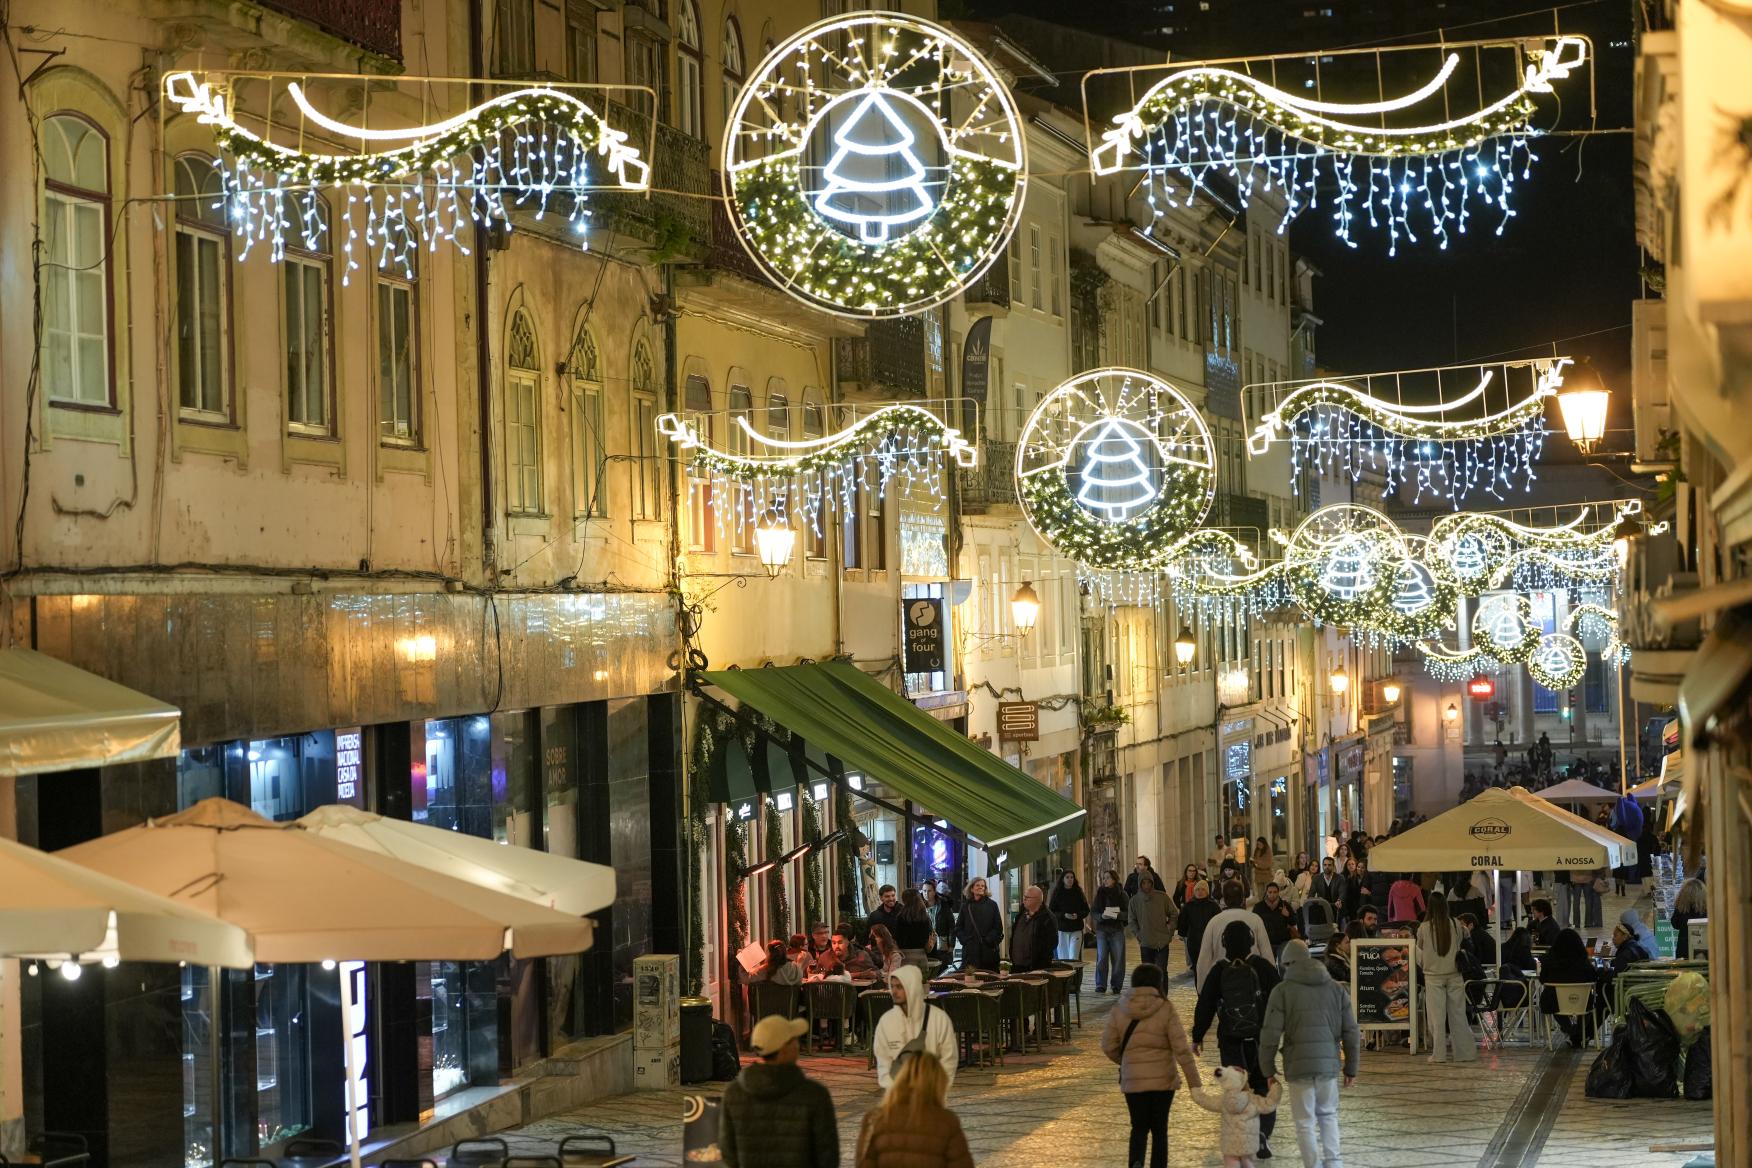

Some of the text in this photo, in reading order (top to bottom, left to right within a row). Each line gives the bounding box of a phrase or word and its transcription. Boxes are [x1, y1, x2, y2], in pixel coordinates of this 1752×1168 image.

[910, 628, 936, 638] gang
[912, 642, 935, 652] four
[338, 750, 360, 767] NACIONAL
[546, 746, 567, 766] SOBRE
[1474, 826, 1508, 834] CORAL
[1471, 856, 1504, 866] CORAL
[1556, 856, 1562, 864] À
